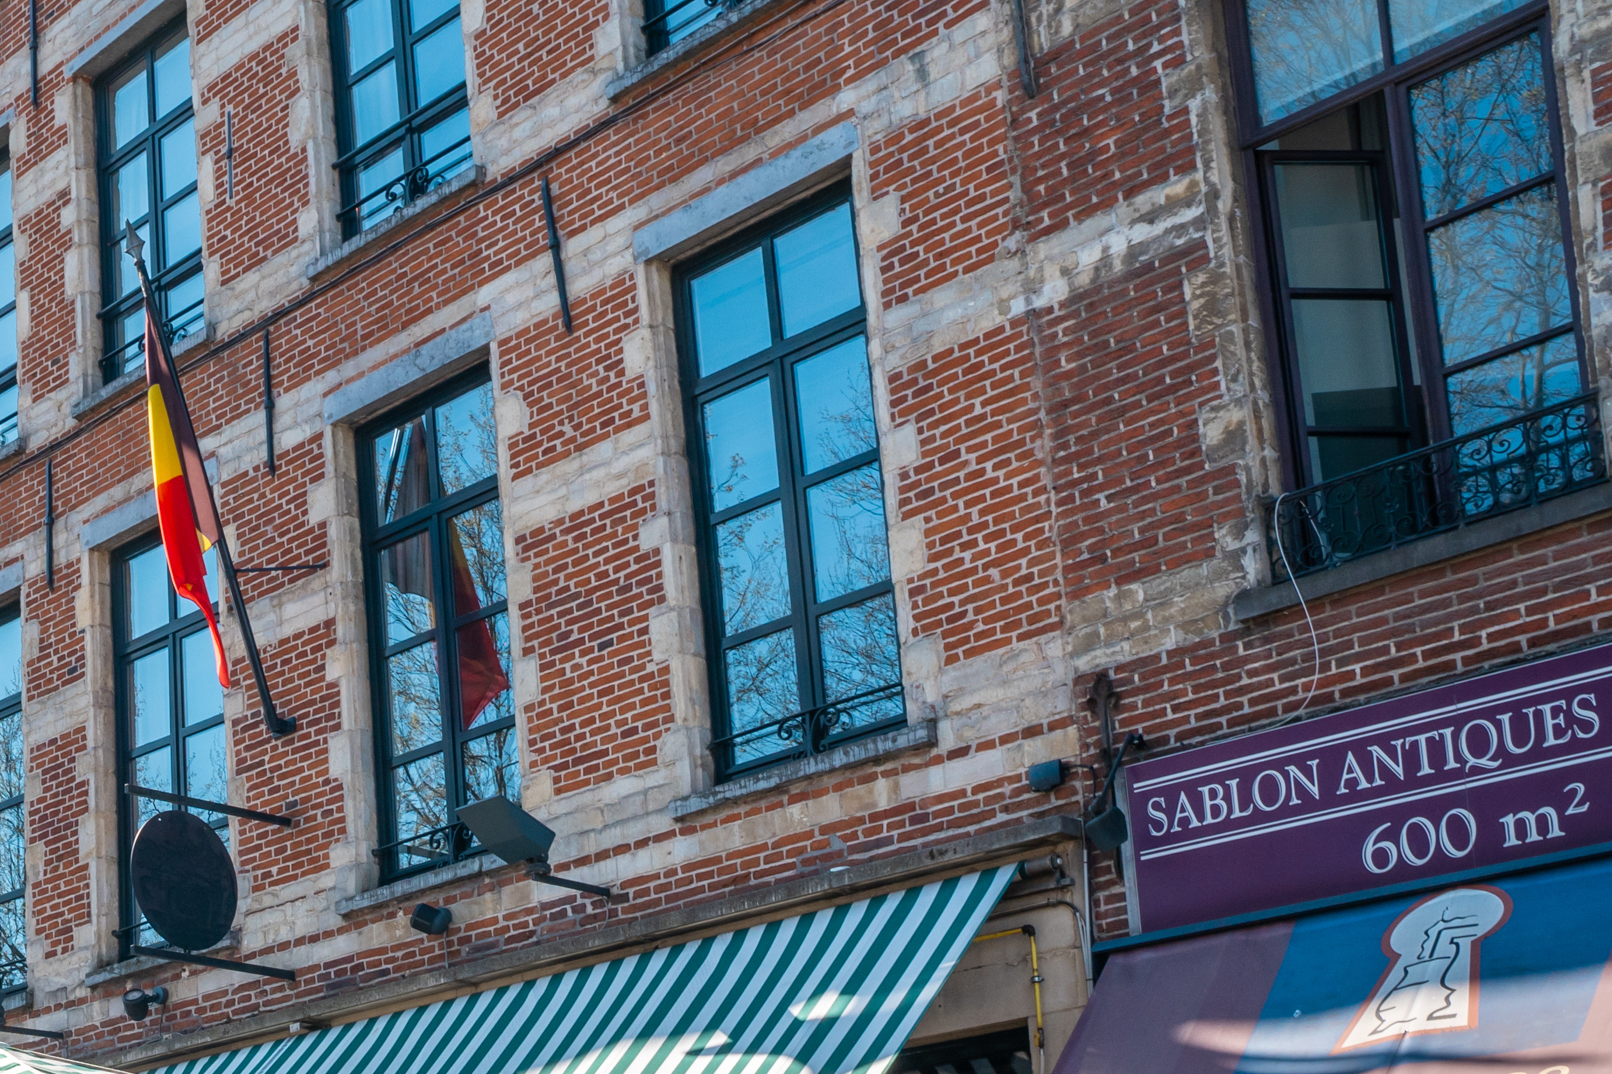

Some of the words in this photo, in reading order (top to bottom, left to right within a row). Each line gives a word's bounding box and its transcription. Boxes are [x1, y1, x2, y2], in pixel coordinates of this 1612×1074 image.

[1146, 759, 1321, 837] SABLON
[1336, 693, 1601, 796] ANTIQUES
[1361, 807, 1477, 874] 600
